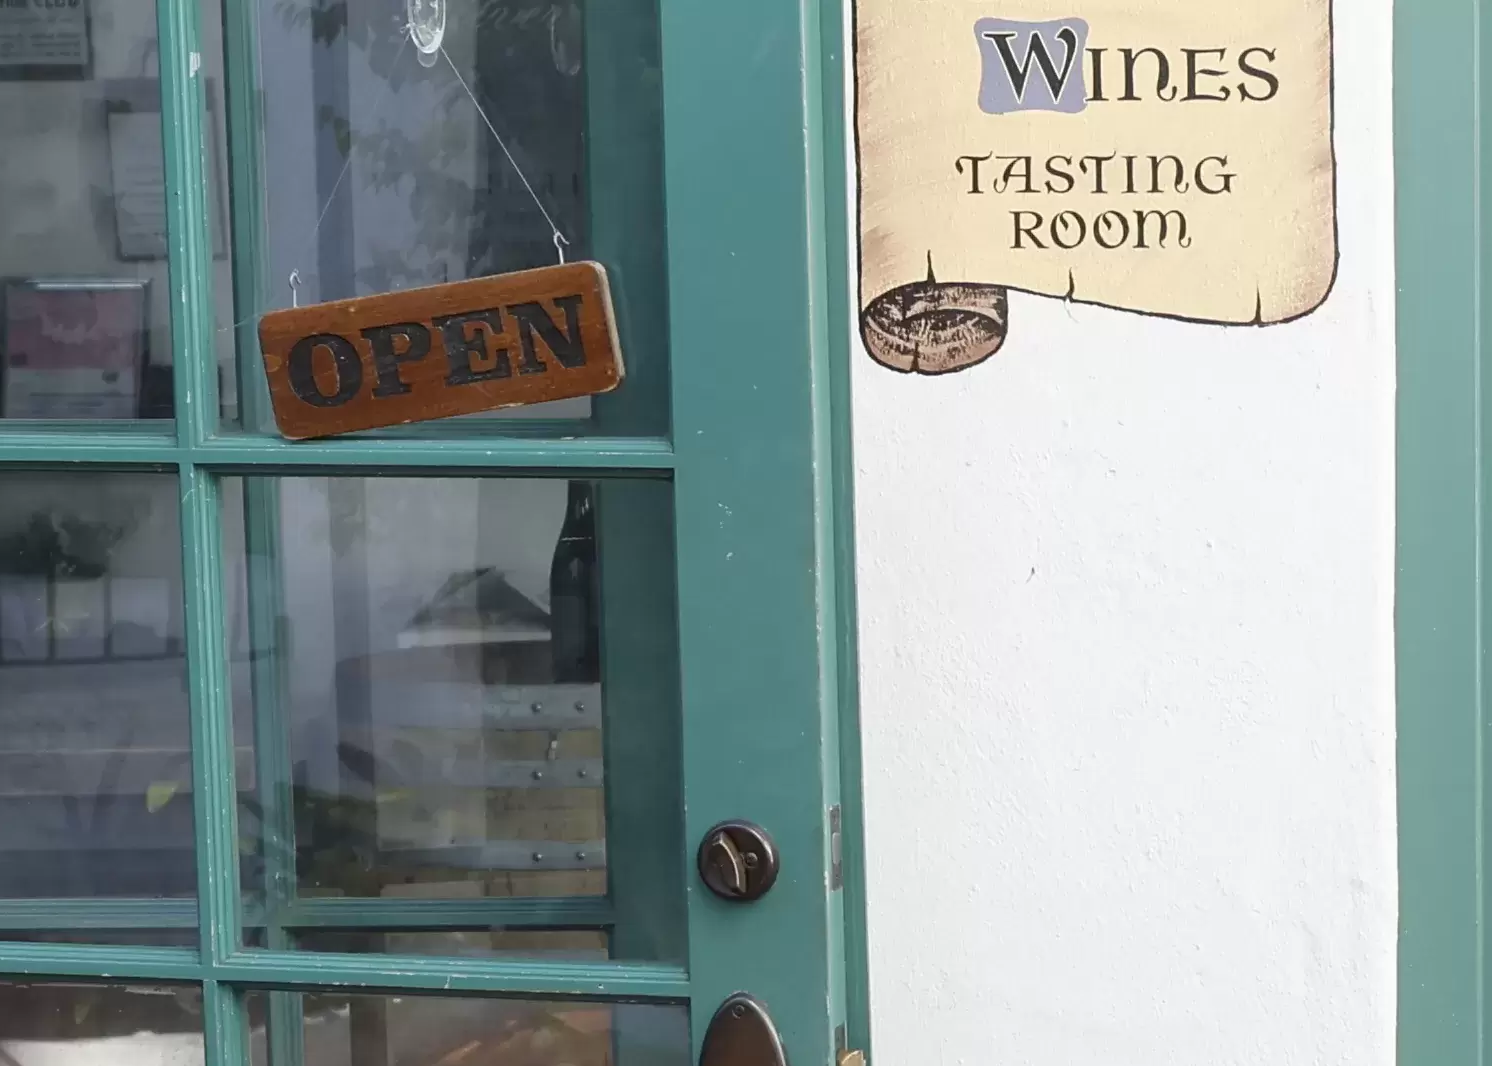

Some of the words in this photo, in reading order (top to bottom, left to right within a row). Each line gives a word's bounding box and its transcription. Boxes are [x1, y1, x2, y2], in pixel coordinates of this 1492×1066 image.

[983, 26, 1280, 103] WINES
[955, 151, 1237, 194] TASTING
[1009, 209, 1192, 249] ROOM
[288, 294, 587, 408] OPEN
